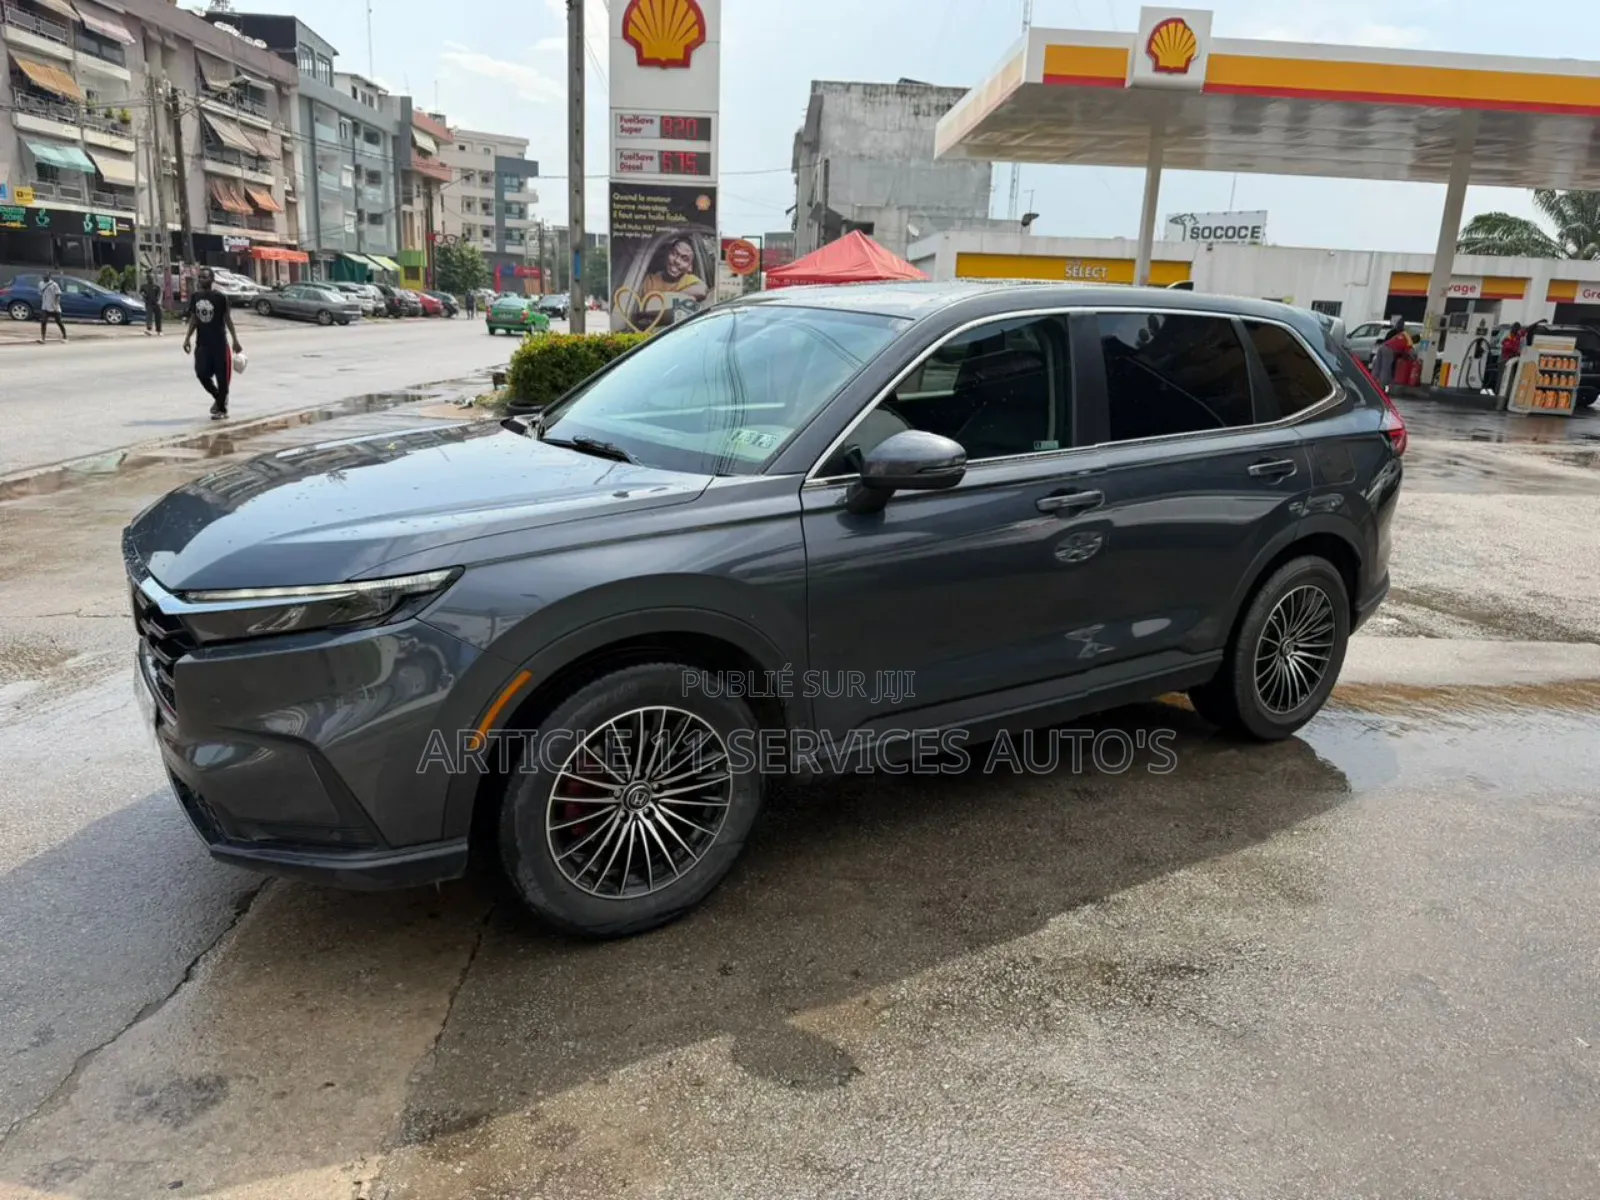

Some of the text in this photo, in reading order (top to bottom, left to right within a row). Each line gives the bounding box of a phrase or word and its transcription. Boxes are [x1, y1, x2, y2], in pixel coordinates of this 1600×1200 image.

[620, 115, 654, 125] FuelSave
[620, 125, 642, 134] Super
[620, 152, 654, 162] FuelSave
[620, 163, 643, 172] Diesel
[1190, 225, 1261, 240] SOCOCE
[1065, 265, 1108, 278] SELECT
